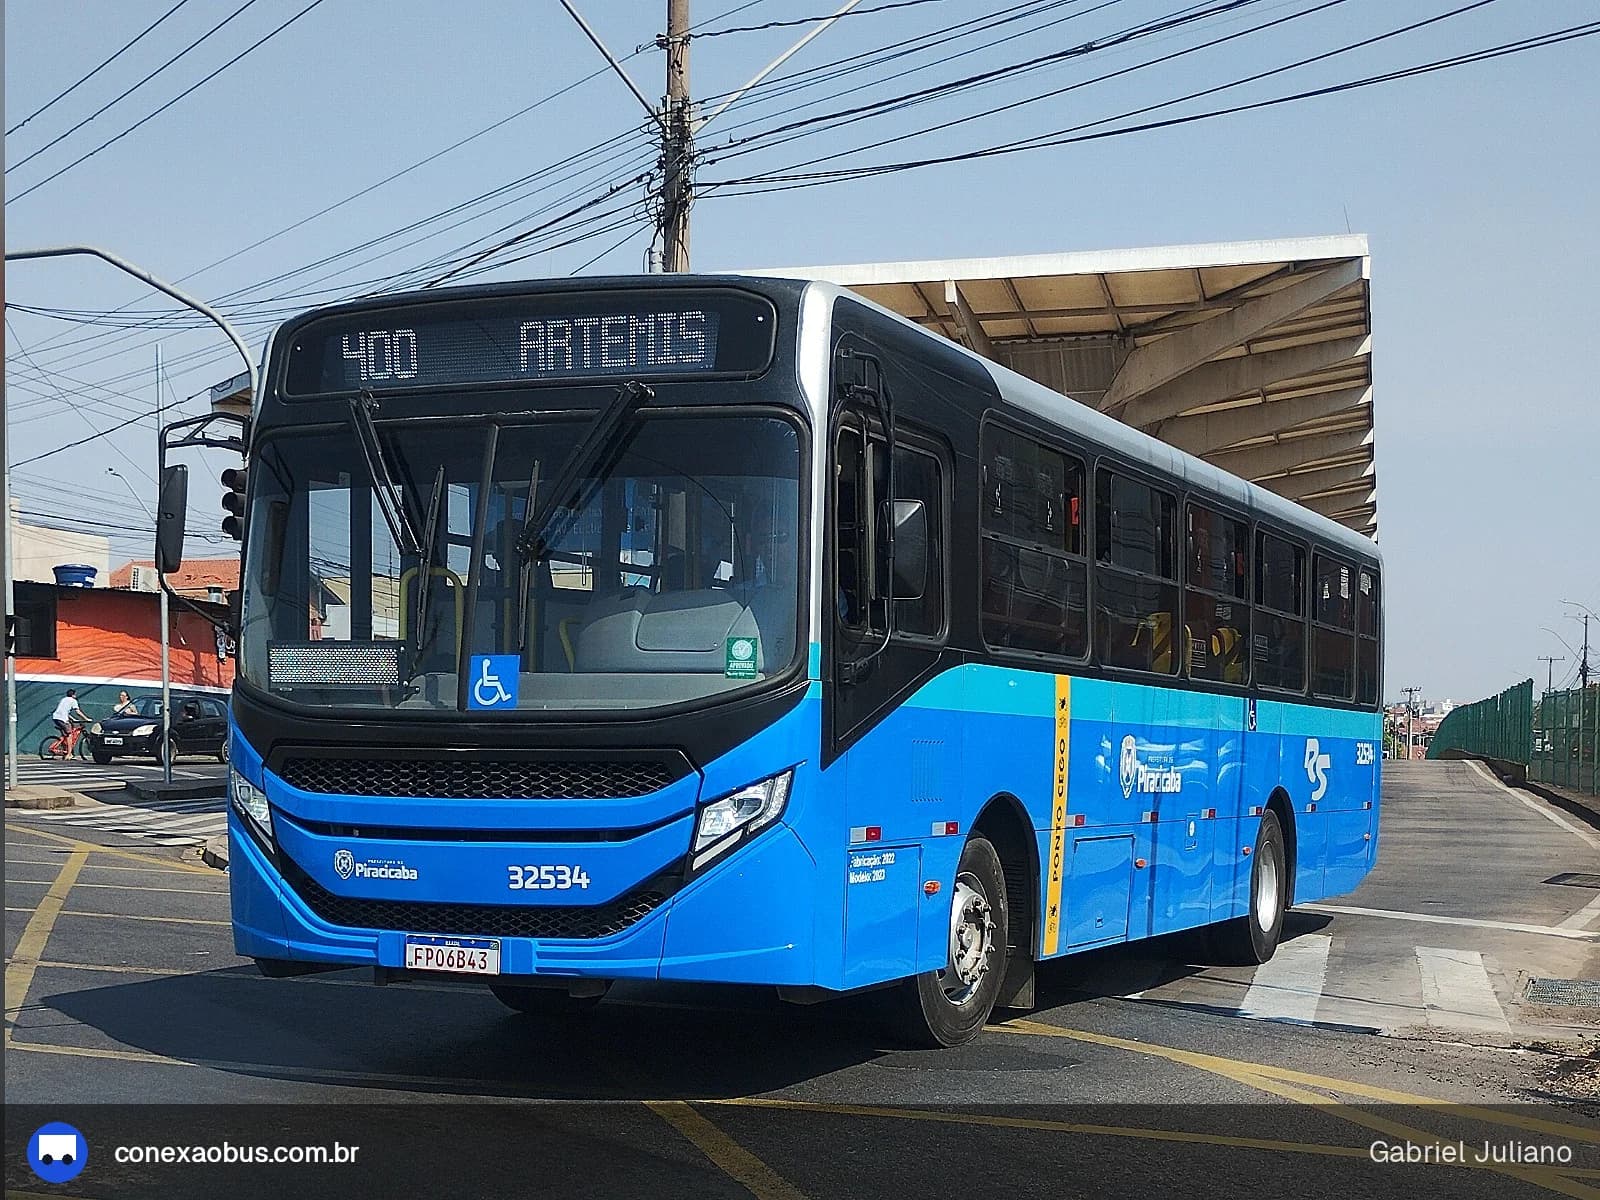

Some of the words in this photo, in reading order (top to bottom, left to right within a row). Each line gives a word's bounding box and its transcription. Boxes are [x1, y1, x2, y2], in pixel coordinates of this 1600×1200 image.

[342, 328, 418, 381] 400
[519, 310, 706, 374] ARTEMIS
[1057, 738, 1066, 798] CEGO
[1136, 764, 1182, 793] Piracicaba
[1052, 805, 1063, 882] PONTO
[355, 862, 418, 880] Piracicaba
[507, 864, 591, 890] 32534
